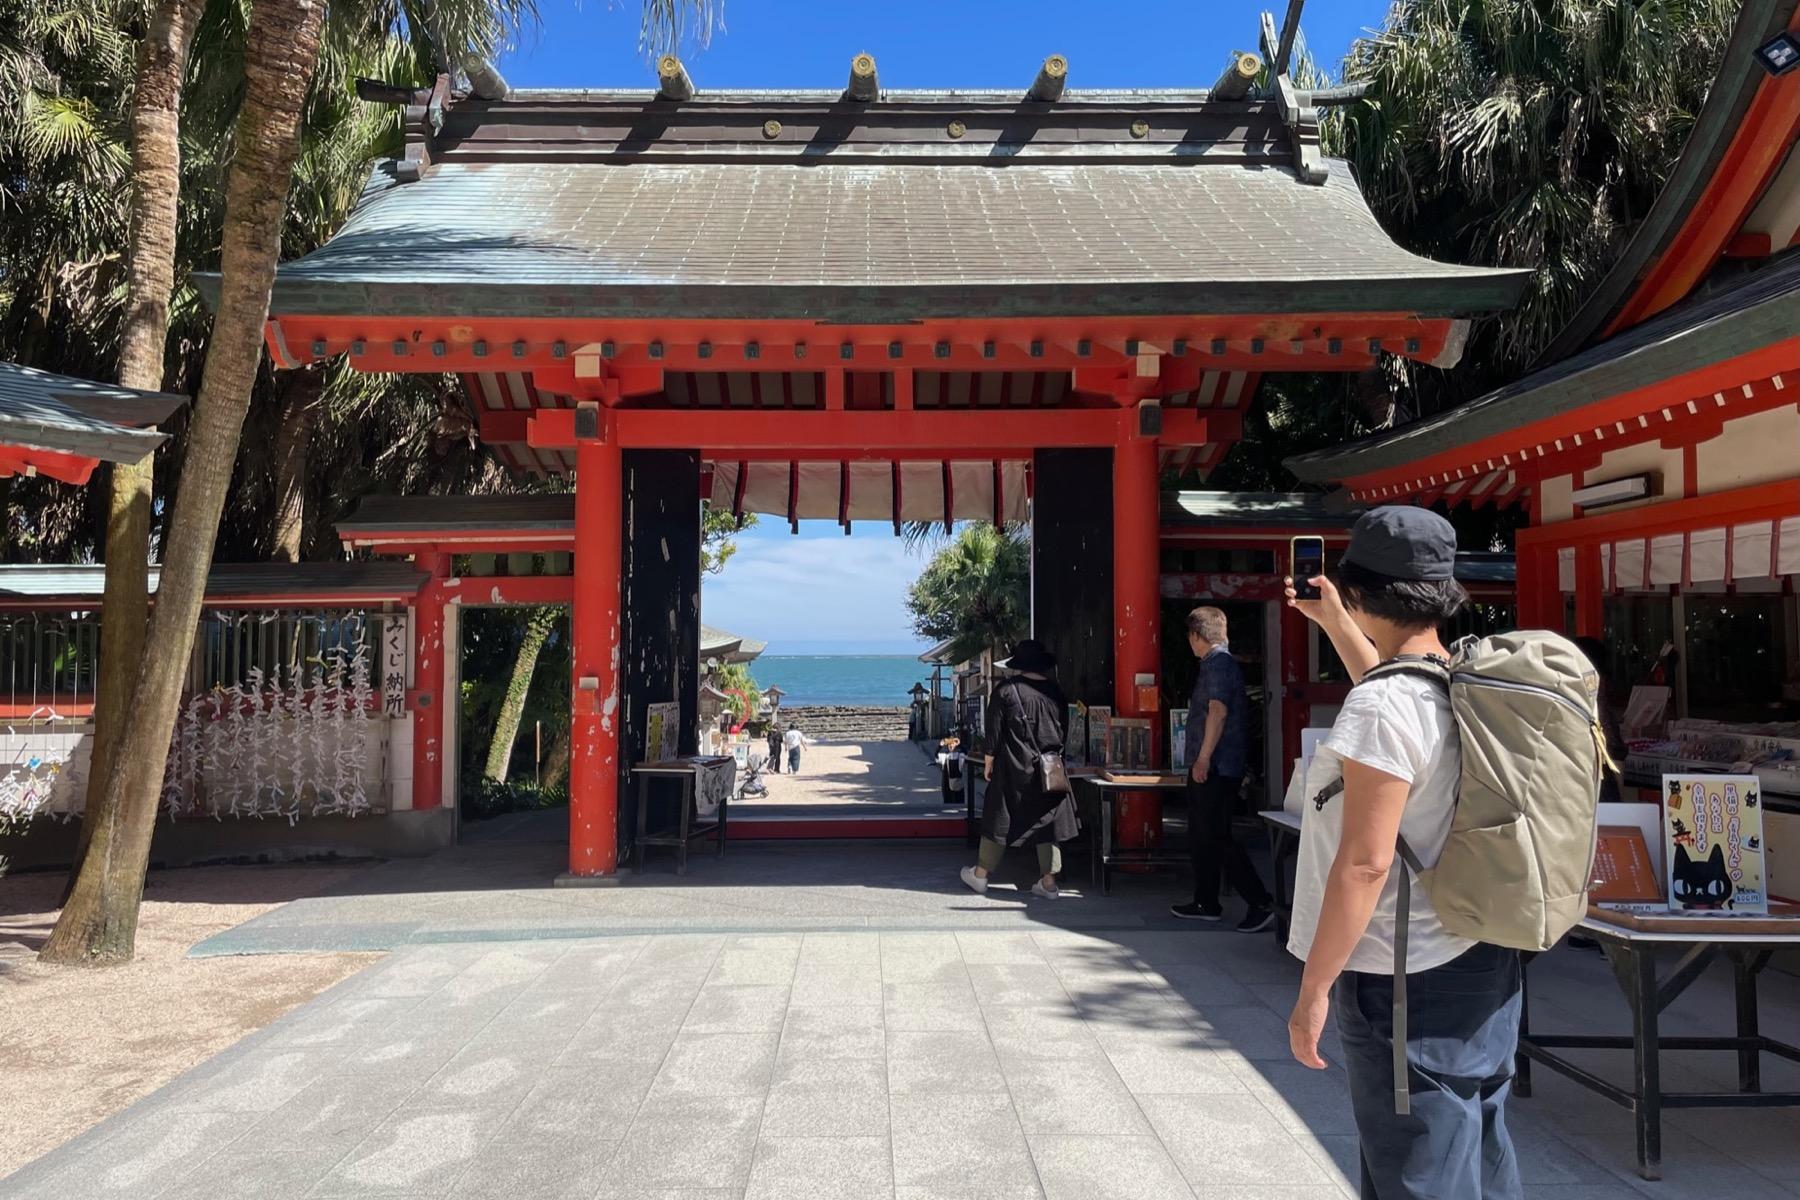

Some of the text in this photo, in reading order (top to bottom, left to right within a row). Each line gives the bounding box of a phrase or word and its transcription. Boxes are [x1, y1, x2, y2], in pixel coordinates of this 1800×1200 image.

[385, 615, 405, 713] みくじ納所
[1711, 795, 1722, 832] あなたに
